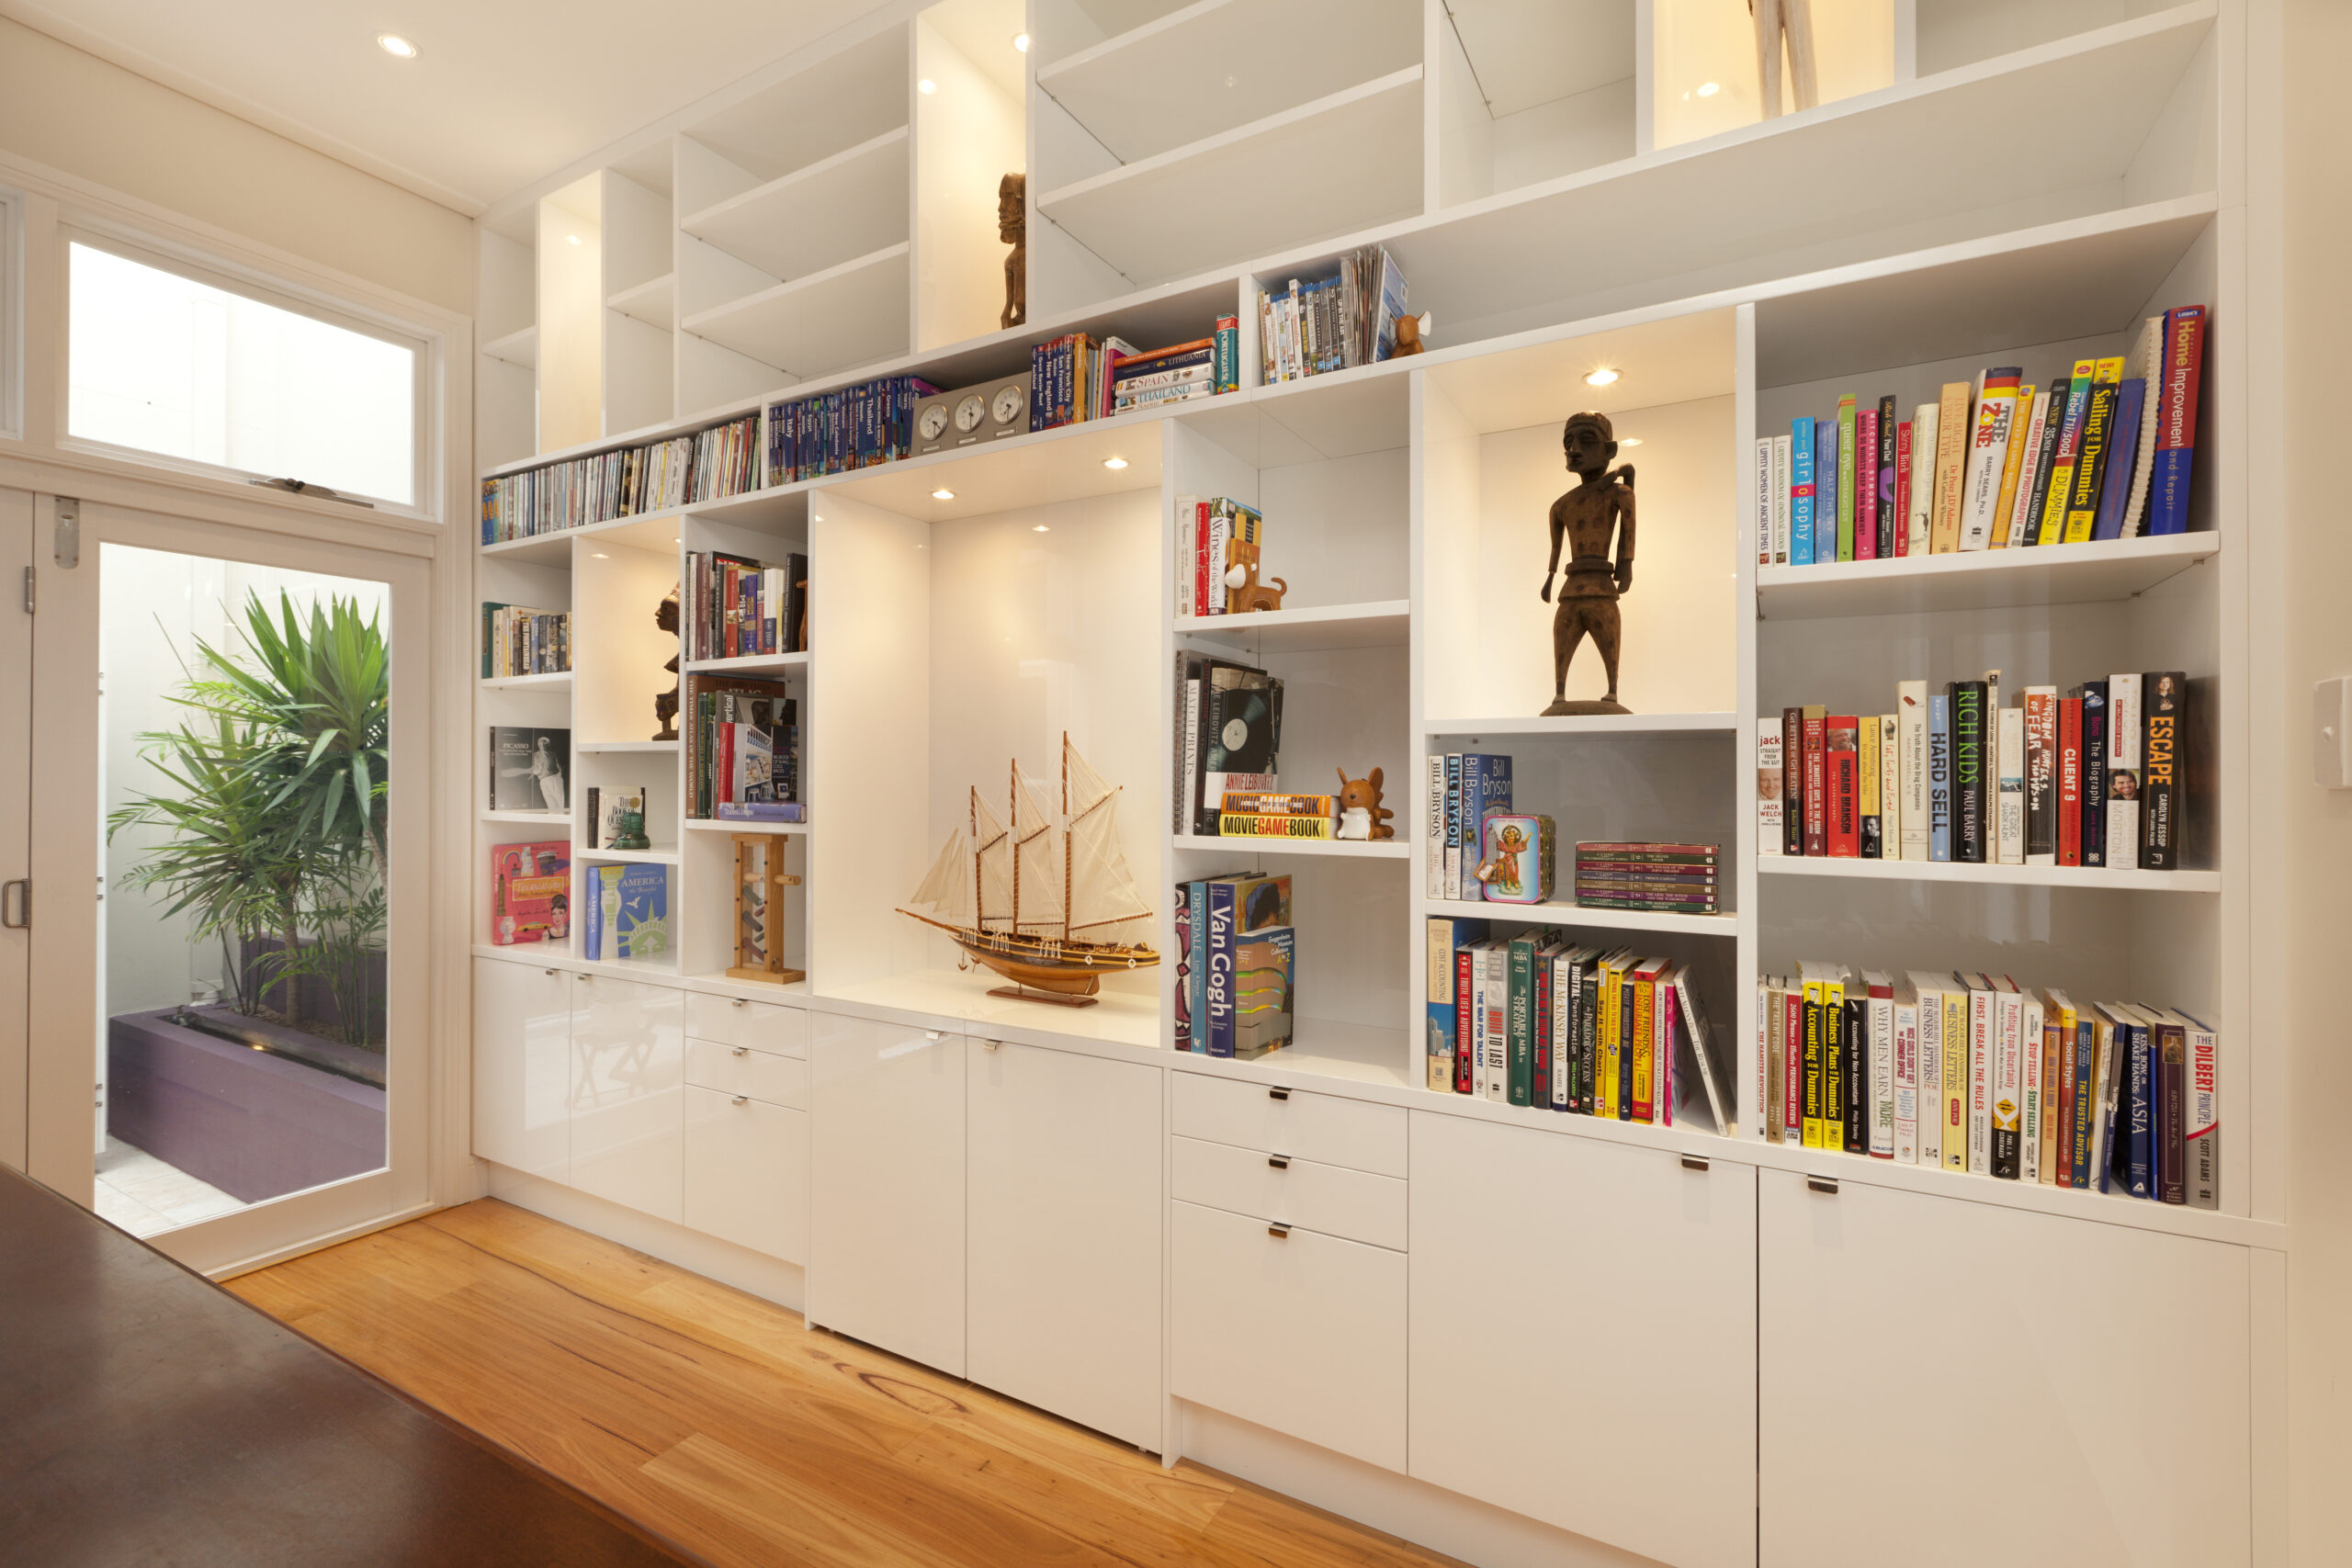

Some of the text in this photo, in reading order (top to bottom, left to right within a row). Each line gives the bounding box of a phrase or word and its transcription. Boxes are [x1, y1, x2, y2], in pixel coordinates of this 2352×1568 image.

[1168, 352, 1206, 365] LITHUANIA
[1137, 374, 1169, 388] SPAIN
[1139, 384, 1191, 403] THAILAND
[2170, 321, 2195, 447] Home Improvement
[2071, 392, 2081, 415] Rebel
[2084, 389, 2111, 434] Sailing
[1841, 423, 1851, 451] queer
[1976, 403, 2011, 448] THE ZONE
[2076, 445, 2101, 505] Dummies
[2170, 451, 2178, 470] and
[2016, 476, 2033, 525] PHOTOGRAPHY
[1958, 690, 1978, 783] RICH KIDS
[2028, 715, 2041, 750] FEAR
[2042, 693, 2055, 740] KINGDOM
[1759, 735, 1780, 746] jack
[2089, 716, 2102, 807] Bono The Biography
[2148, 716, 2174, 785] ESCAPE
[1225, 773, 1244, 790] ANNIE
[1482, 774, 1512, 798] Bryson
[1493, 759, 1505, 776] Bill
[1931, 733, 1948, 833] HARD SELL
[2064, 748, 2076, 791] CLIENT
[1448, 758, 1459, 846] BILL BRYSON
[1464, 758, 1478, 825] Bill Bryson
[1840, 759, 1851, 834] RICHARD BRANSON
[2158, 793, 2167, 820] CAROLYN
[1432, 792, 1440, 837] BRYSON
[1963, 790, 1975, 843] PAUL BARRY
[621, 878, 664, 887] AMERICA
[1193, 892, 1202, 952] DRYSDALE
[1208, 906, 1232, 1017] Van Gogh
[1571, 966, 1581, 997] DIGITAL
[1805, 1006, 1819, 1061] Accounting
[1829, 1007, 1840, 1044] Business
[1976, 1023, 1985, 1050] BREAK
[2005, 1004, 2018, 1033] Profiting
[1829, 1046, 1840, 1070] Plans
[1976, 1051, 1985, 1065] ALL
[2006, 1035, 2018, 1048] from
[2132, 1033, 2140, 1057] SHAKE
[1878, 1007, 1893, 1128] WHY MEN EARN MORE
[1976, 1068, 1985, 1083] THE
[2064, 1041, 2074, 1089] Social Styles
[2195, 1035, 2214, 1125] THE DILBERT PRINCIPLE
[1807, 1071, 1819, 1117] Dummies
[1828, 1076, 1840, 1119] Dummies
[1975, 1085, 1984, 1110] RULES
[2132, 1097, 2147, 1134] ASIA
[2075, 1080, 2087, 1166] THE TRUSTED ADVISOR
[2200, 1139, 2210, 1182] SCOTT ADAMS
